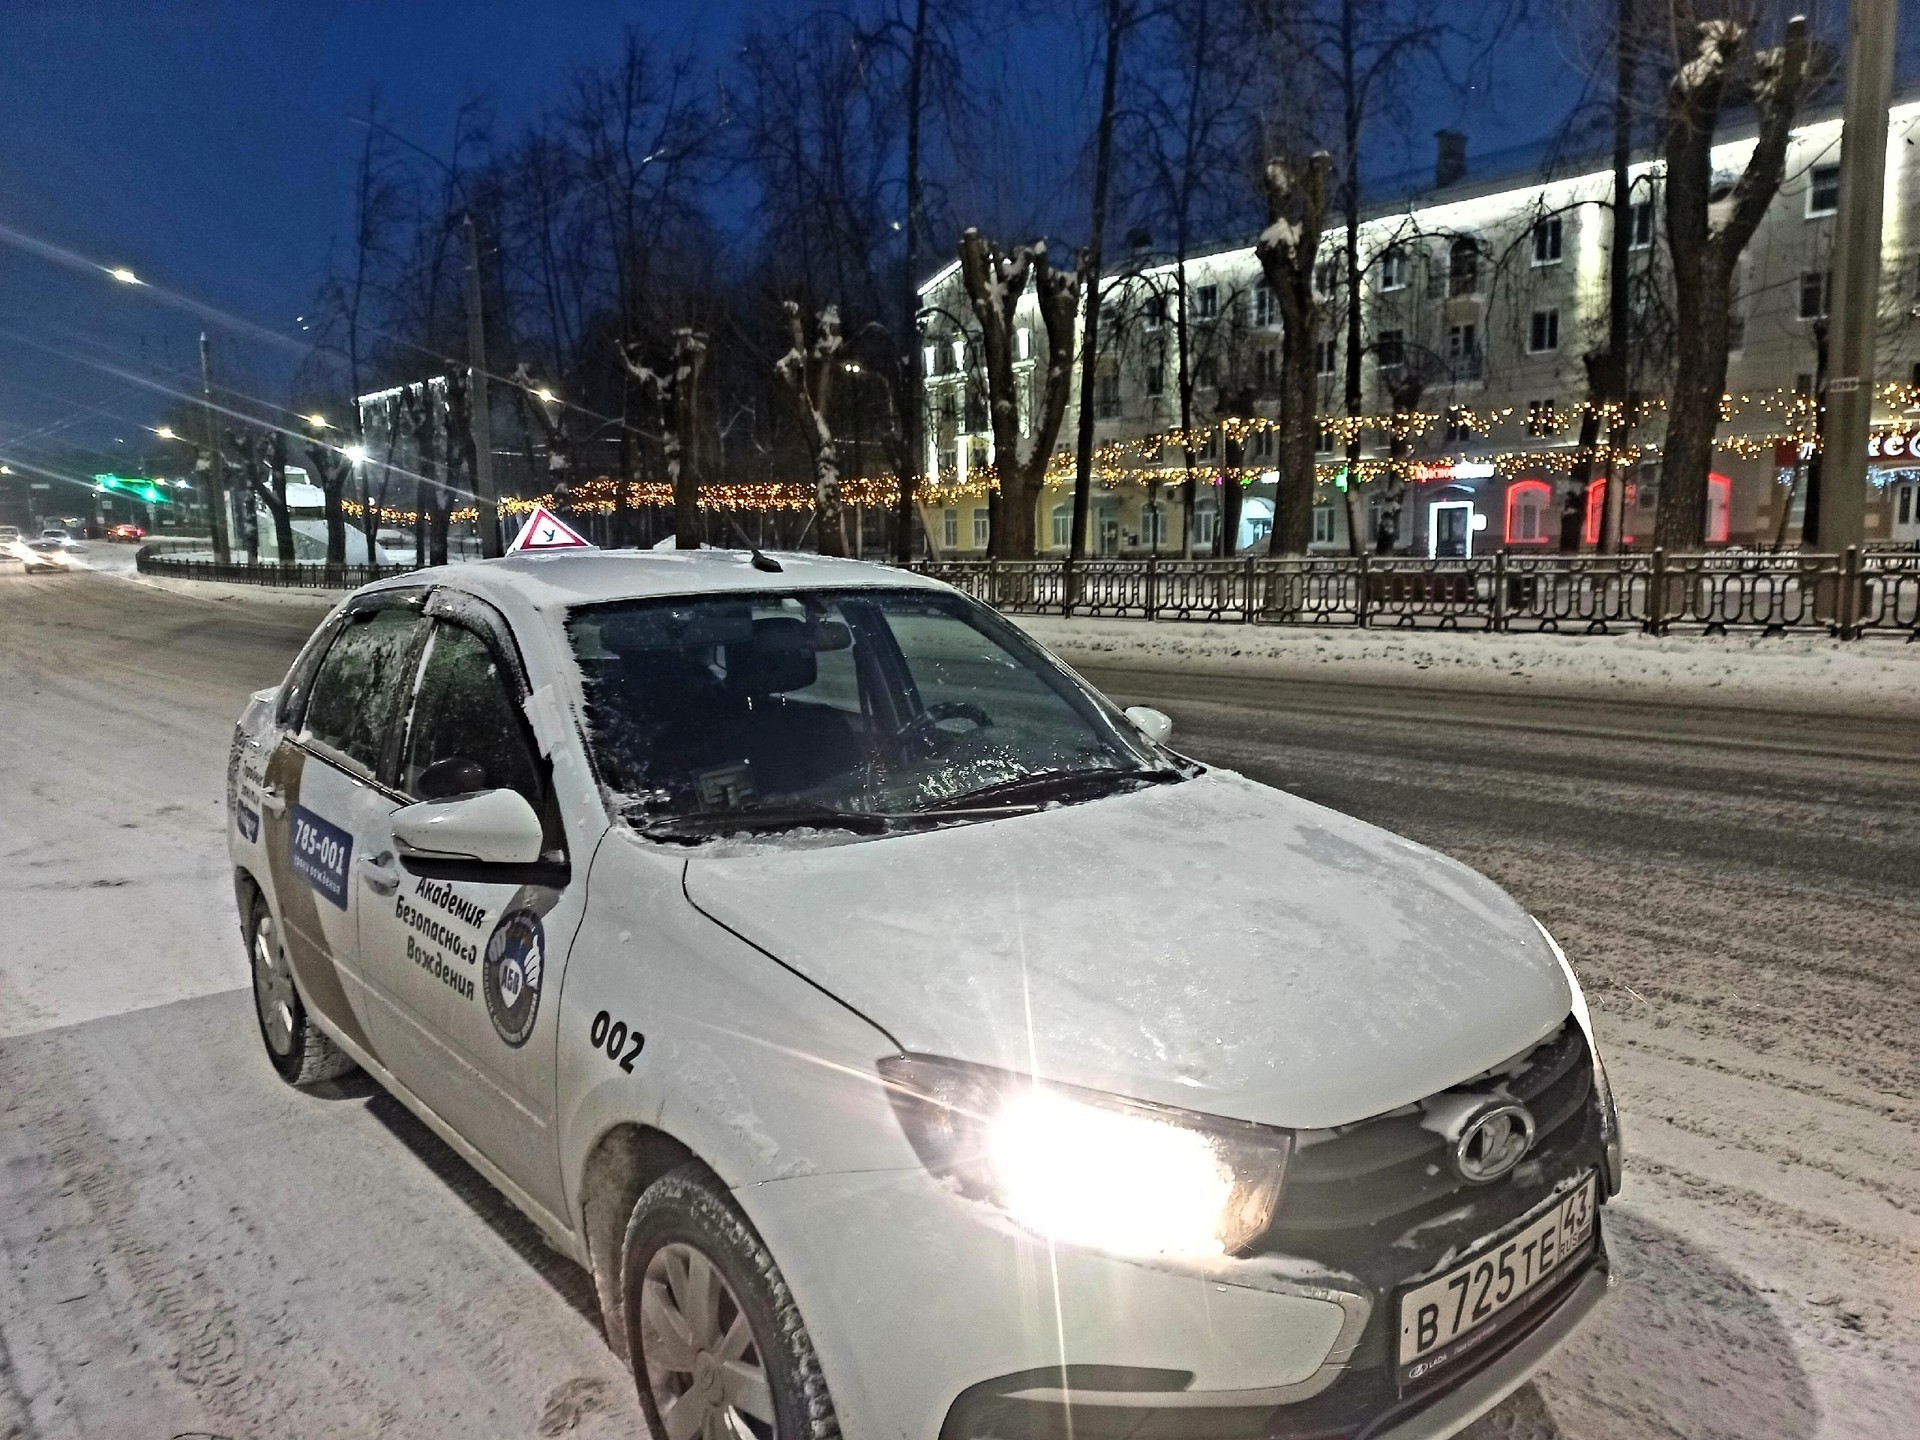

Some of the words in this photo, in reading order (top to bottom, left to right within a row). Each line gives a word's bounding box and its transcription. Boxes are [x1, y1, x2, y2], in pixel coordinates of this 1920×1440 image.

[542, 529, 556, 542] У
[295, 819, 345, 875] 785-001
[415, 877, 486, 929] Академия
[407, 936, 475, 1001] Вождения
[590, 1010, 645, 1075] 002
[1563, 1185, 1589, 1235] 43
[1560, 1232, 1579, 1255] RUS
